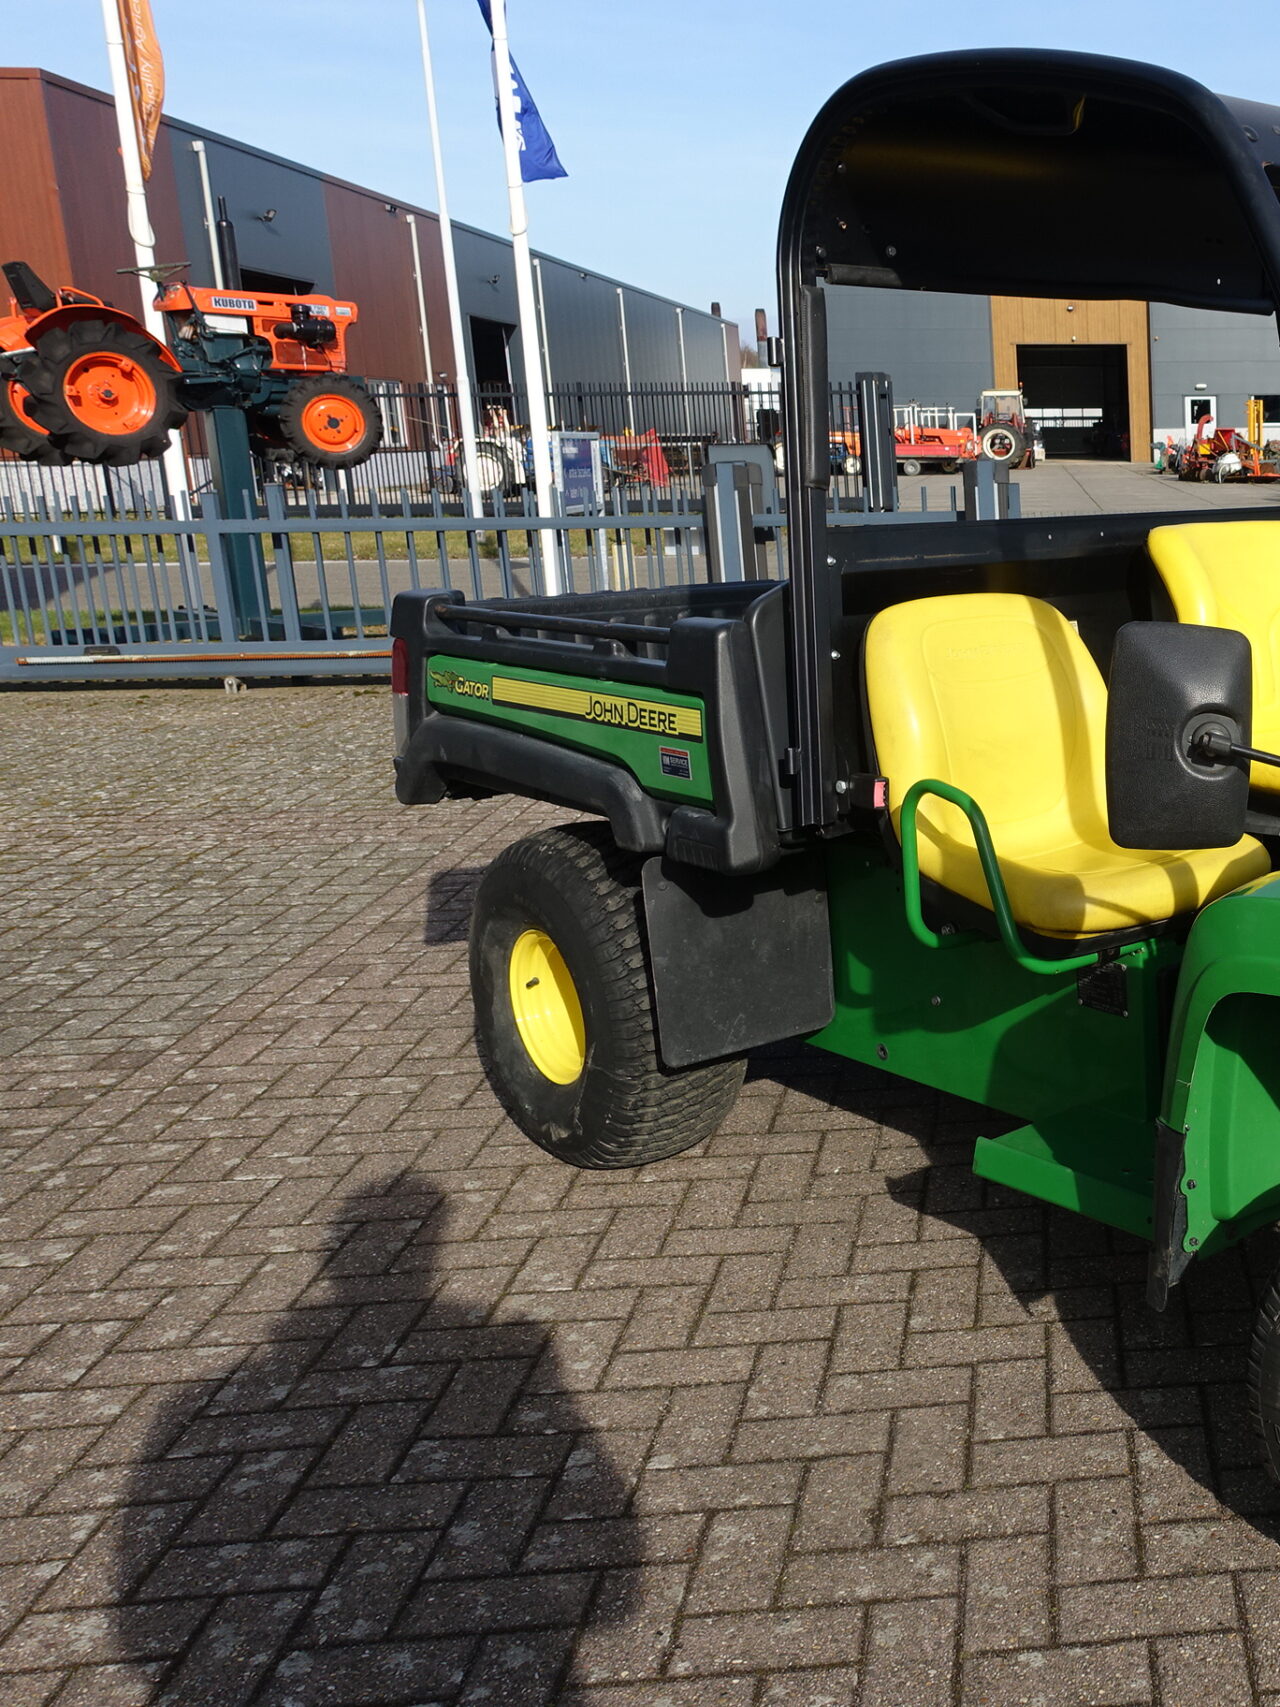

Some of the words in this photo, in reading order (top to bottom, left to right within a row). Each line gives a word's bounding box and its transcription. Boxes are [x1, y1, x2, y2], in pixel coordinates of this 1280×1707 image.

[213, 296, 255, 310] KUBOTA
[455, 676, 490, 699] GATOR
[585, 695, 625, 722] JOHN
[627, 701, 679, 733] DEERE
